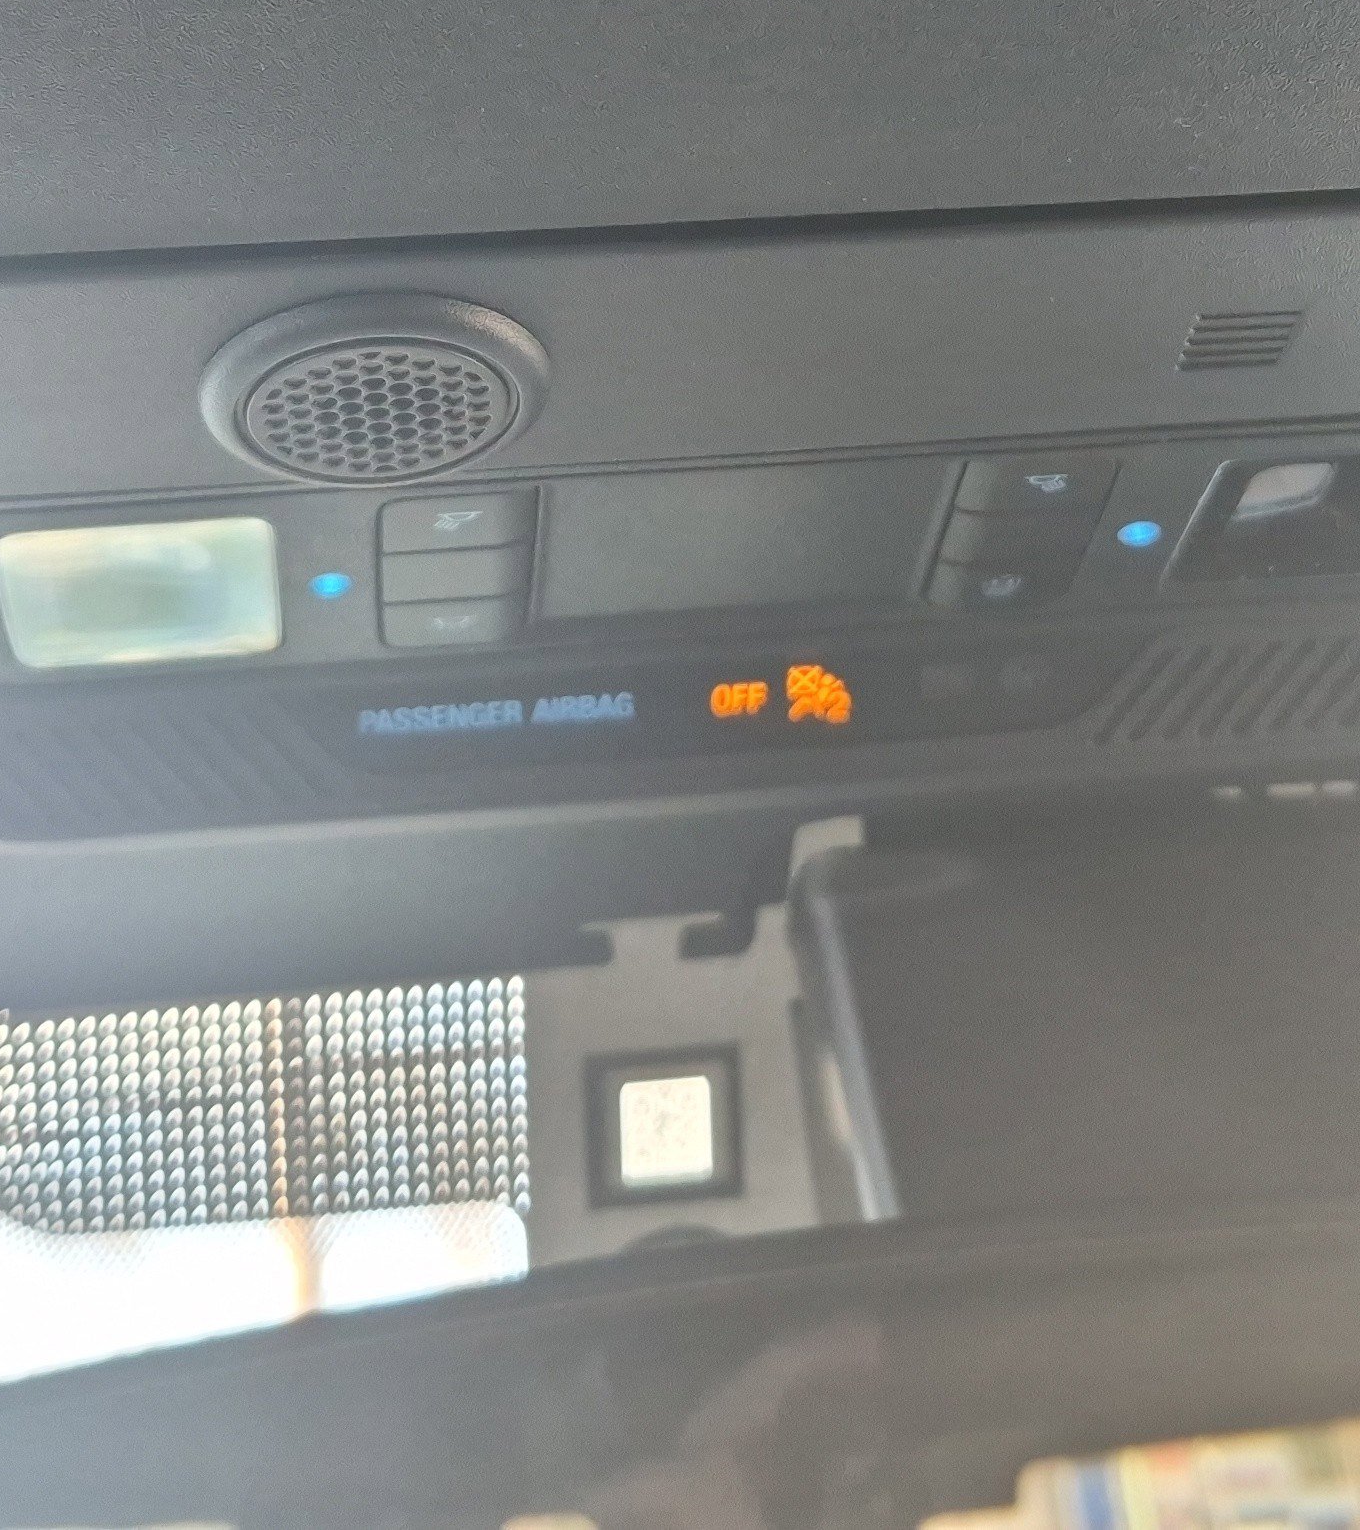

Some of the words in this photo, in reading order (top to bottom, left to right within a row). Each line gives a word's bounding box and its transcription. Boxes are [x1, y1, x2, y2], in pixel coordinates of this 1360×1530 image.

[359, 699, 523, 734] PASSENGER
[532, 690, 636, 724] AIRBAG
[710, 681, 769, 718] OFF
